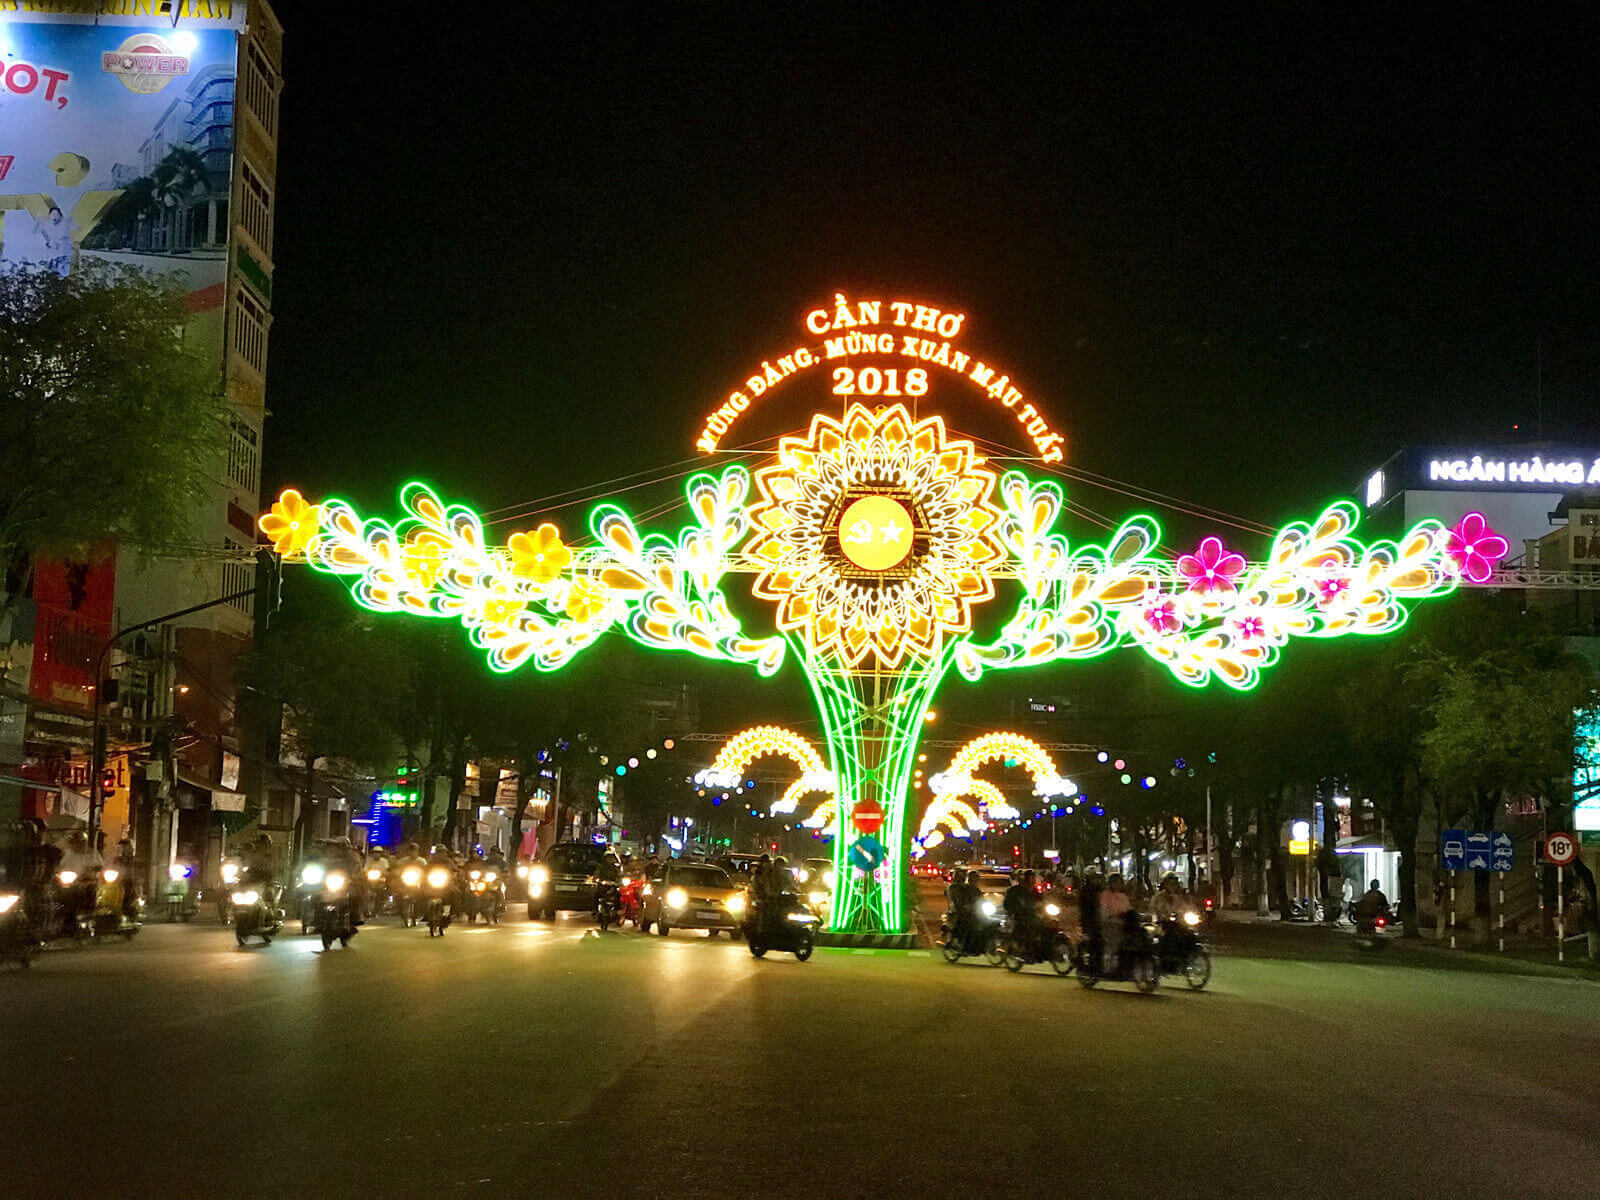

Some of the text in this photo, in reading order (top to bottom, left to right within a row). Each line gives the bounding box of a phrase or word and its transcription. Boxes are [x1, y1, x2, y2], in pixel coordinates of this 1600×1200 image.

[103, 53, 188, 74] POWER
[0, 60, 69, 109] OT,
[806, 293, 965, 338] CẦN THƠ
[823, 330, 895, 360] MỪNG
[900, 336, 971, 373] XUÂN
[969, 361, 1023, 408] MẬU
[1017, 403, 1065, 464] TUẤT
[832, 366, 929, 397] 2018
[1429, 455, 1505, 482] NGÂN
[1508, 456, 1585, 485] HÀNG
